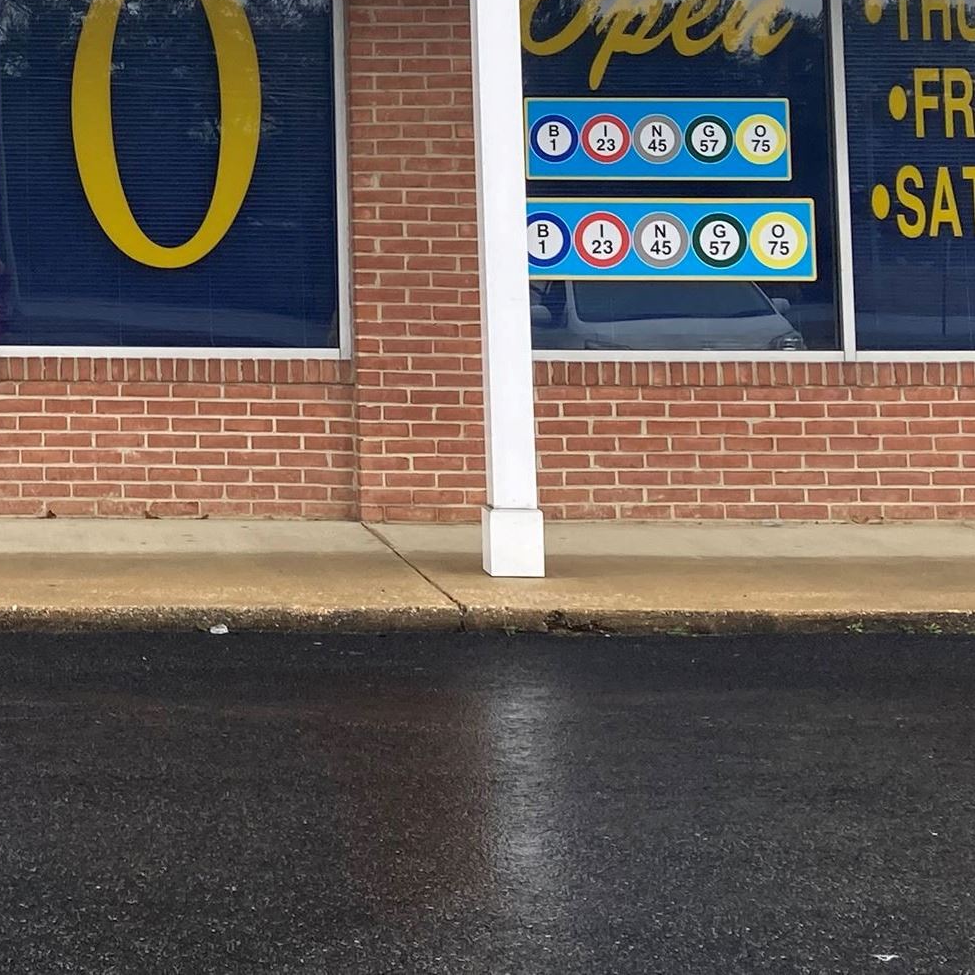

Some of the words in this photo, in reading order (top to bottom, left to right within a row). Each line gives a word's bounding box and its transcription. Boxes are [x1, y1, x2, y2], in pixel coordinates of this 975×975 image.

[912, 66, 975, 139] FR
[549, 124, 560, 137] B
[651, 124, 663, 137] N
[702, 124, 715, 137] G
[754, 124, 767, 137] O
[550, 139, 557, 151] 1
[596, 139, 616, 152] 23
[648, 139, 668, 152] 45
[700, 139, 719, 152] 57
[751, 139, 771, 152] 75
[537, 224, 549, 237] B
[654, 224, 666, 237] N
[712, 224, 726, 238] G
[771, 224, 785, 238] O
[539, 240, 546, 254] 1
[591, 240, 614, 254] 23
[650, 240, 672, 255] 45
[709, 240, 730, 255] 57
[768, 240, 790, 255] 75
